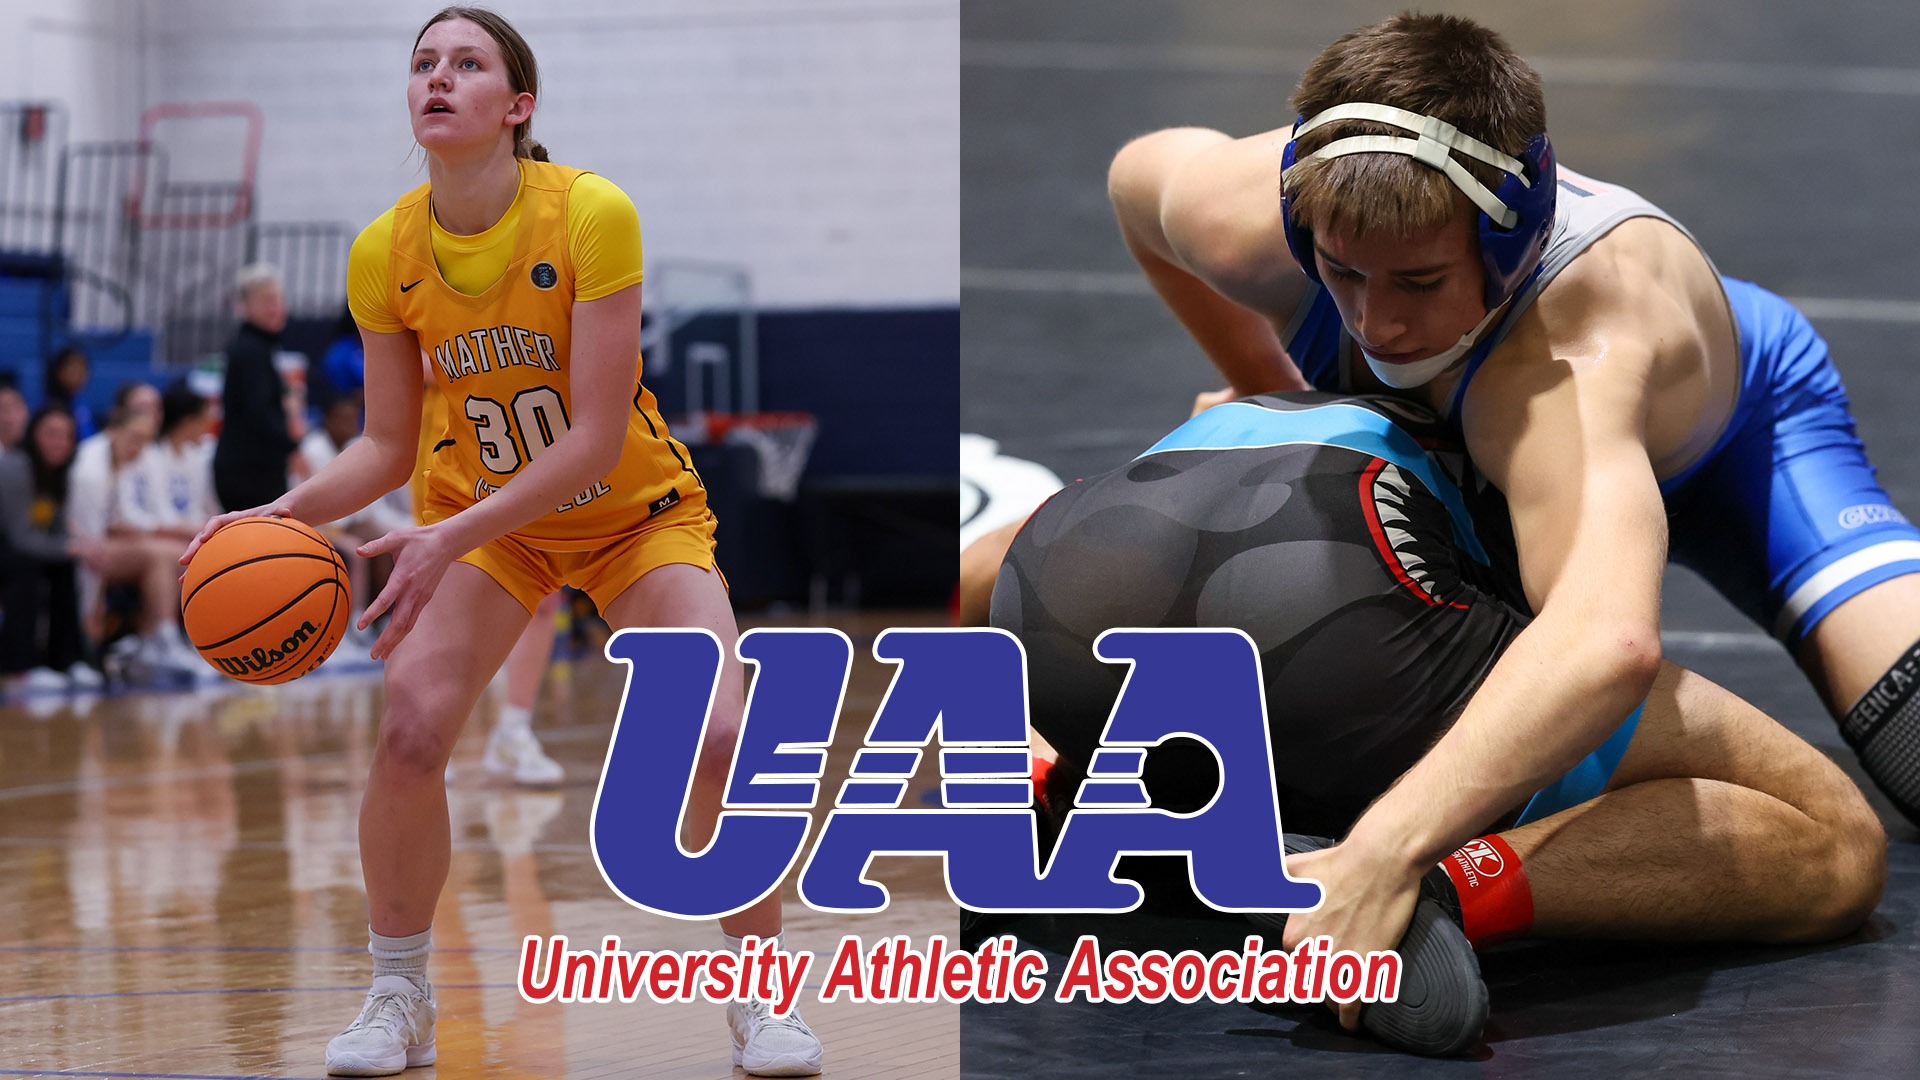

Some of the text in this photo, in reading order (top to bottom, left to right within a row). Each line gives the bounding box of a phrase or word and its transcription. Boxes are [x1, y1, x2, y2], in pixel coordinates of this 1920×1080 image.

[434, 325, 561, 383] MATHER
[464, 385, 573, 474] 30
[212, 621, 318, 675] Wilson
[1456, 857, 1480, 888] ATHLETIC
